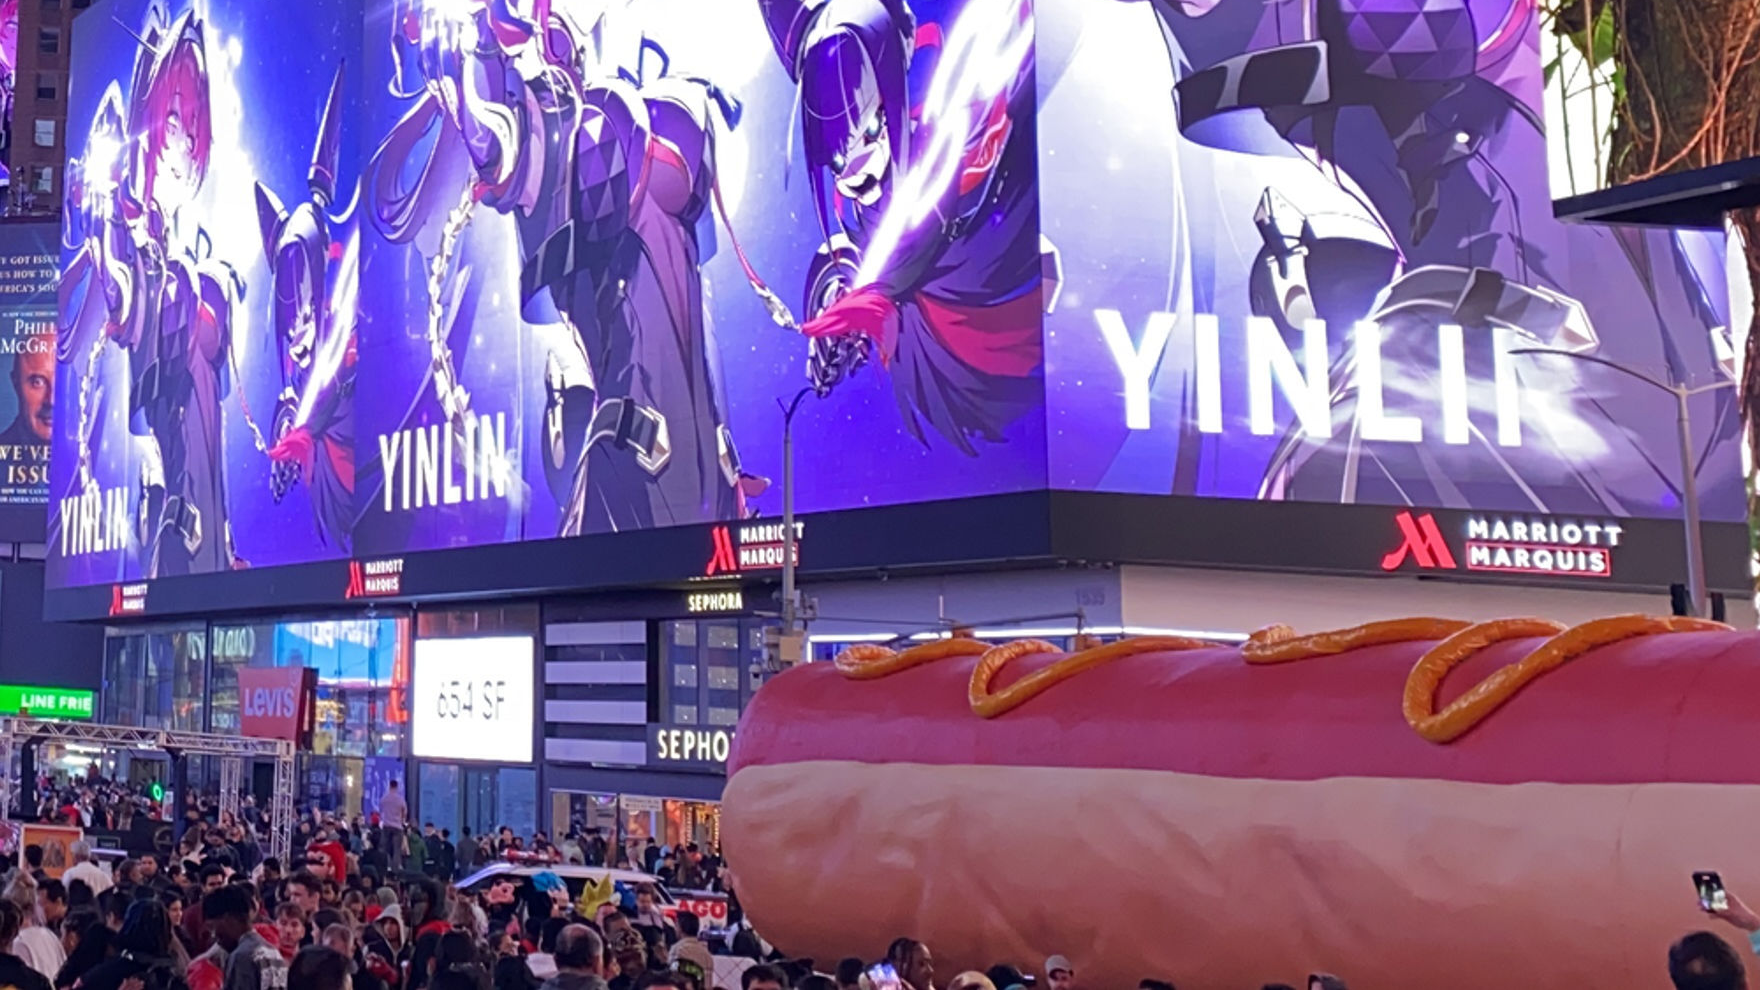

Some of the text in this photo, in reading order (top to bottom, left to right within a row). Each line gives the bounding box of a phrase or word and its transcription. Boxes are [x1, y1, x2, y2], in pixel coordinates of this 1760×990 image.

[10, 255, 30, 266] GOT
[33, 254, 60, 264] ISSUE
[13, 270, 36, 279] HOW
[38, 283, 57, 293] SOU
[14, 318, 58, 335] PHILL
[378, 411, 508, 512] YINLIN
[59, 485, 130, 557] YINLIN
[740, 522, 804, 543] MARRIOT
[1468, 517, 1624, 547] MARRIOTT
[740, 547, 797, 565] MARQUS
[1469, 545, 1608, 574] MARQUIS
[688, 592, 743, 612] SEPHORA
[21, 694, 56, 709] LINE
[483, 680, 506, 720] SF
[657, 729, 731, 762] SEPHO
